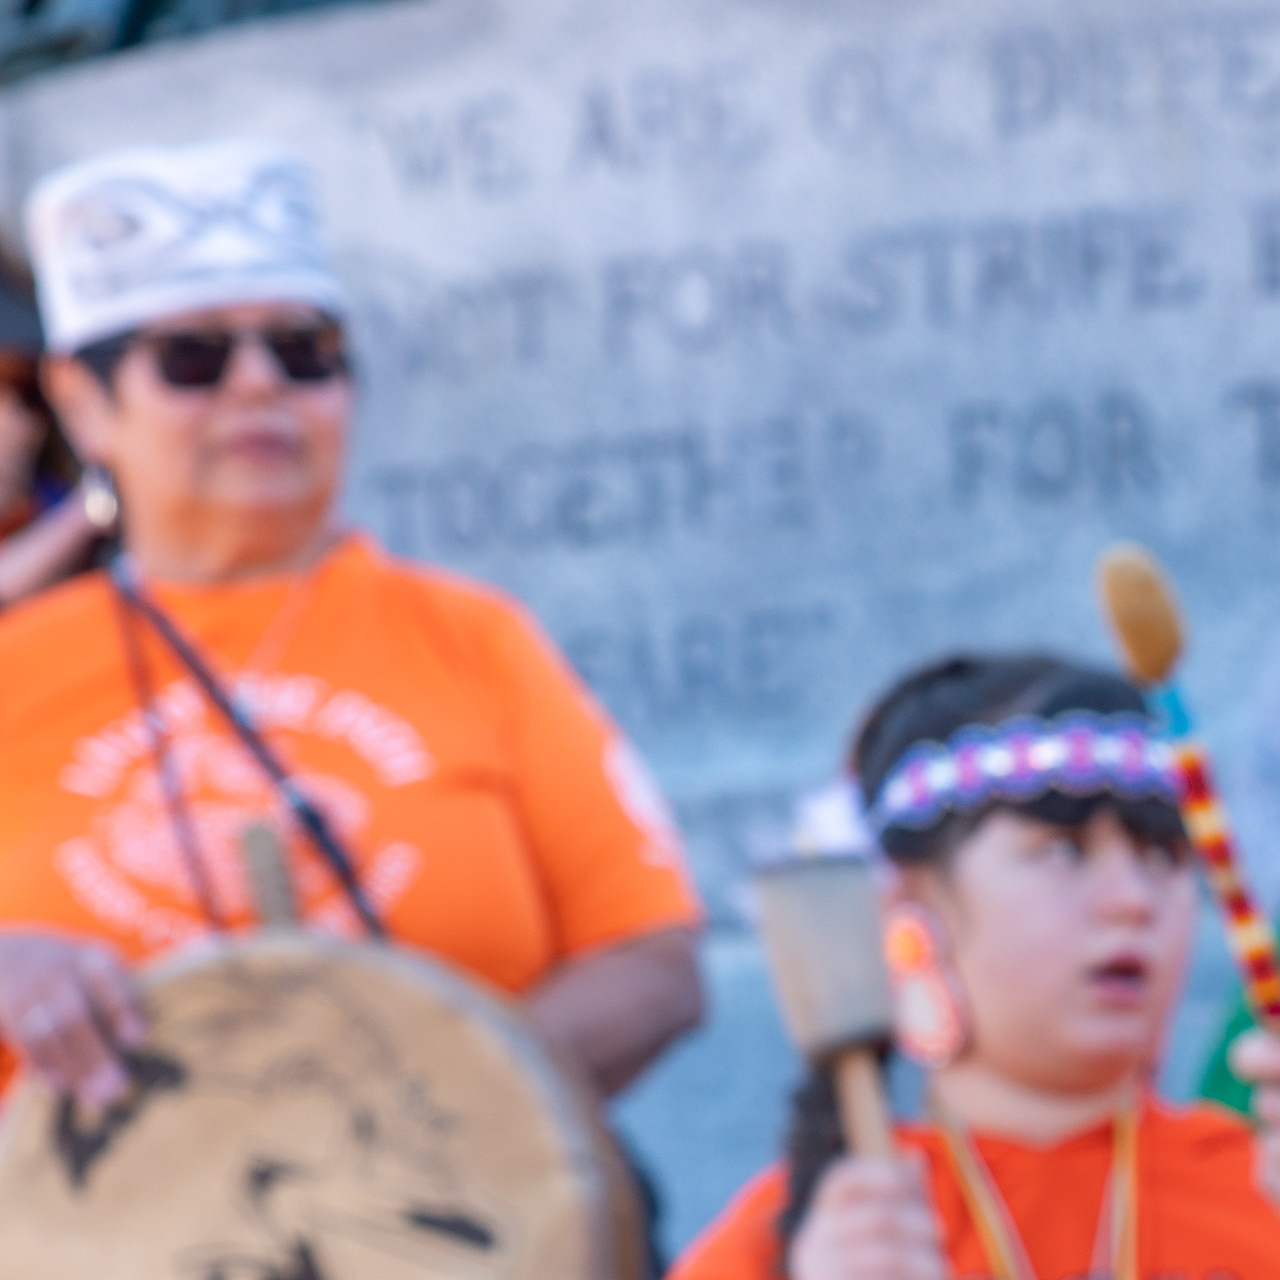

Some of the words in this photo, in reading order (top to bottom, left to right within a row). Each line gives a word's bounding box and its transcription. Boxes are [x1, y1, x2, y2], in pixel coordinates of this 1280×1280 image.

[600, 240, 795, 366] FOR
[818, 204, 1208, 338] STRIFE
[944, 388, 1166, 510] FOR
